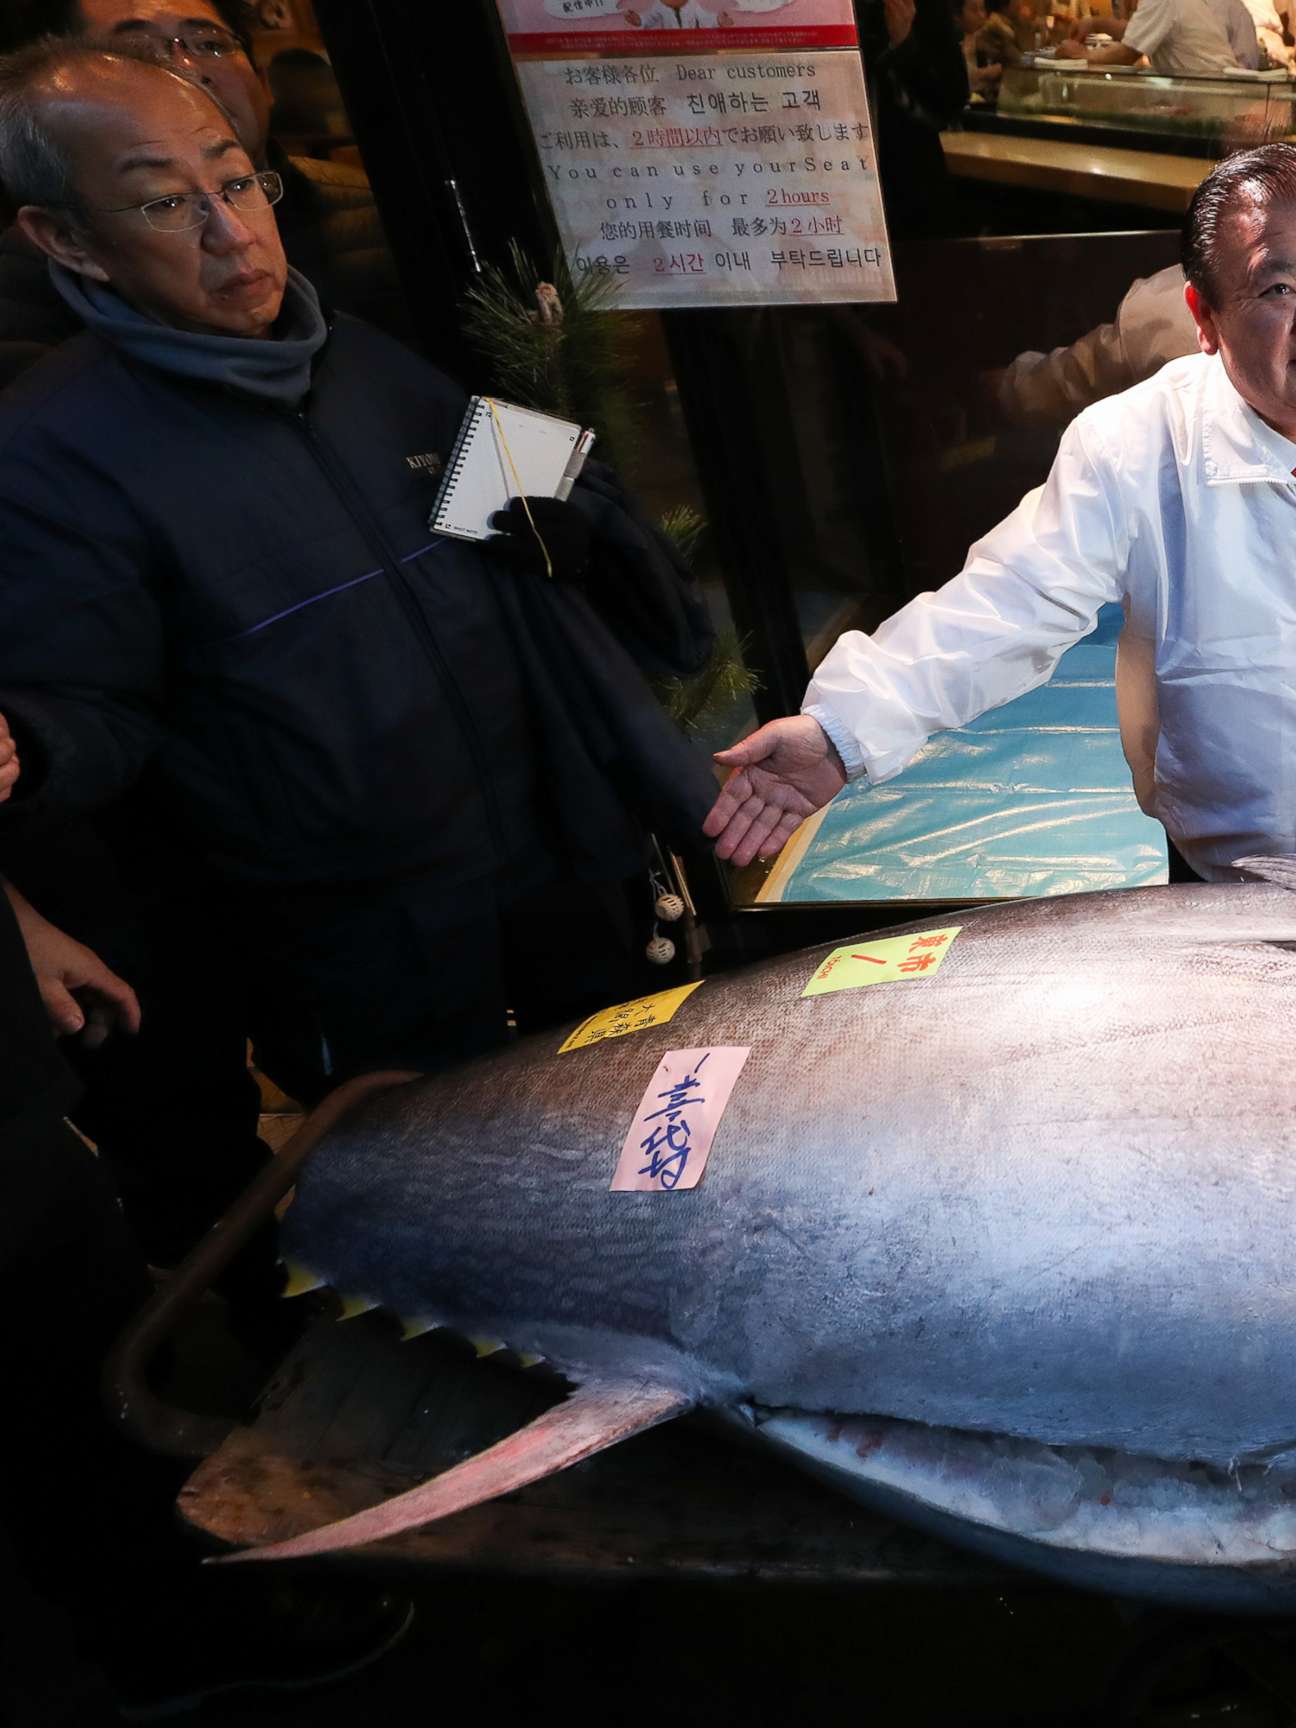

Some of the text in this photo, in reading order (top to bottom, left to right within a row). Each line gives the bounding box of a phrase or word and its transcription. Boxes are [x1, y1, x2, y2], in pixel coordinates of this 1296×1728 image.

[564, 64, 659, 85] お客様各位
[676, 63, 816, 81] Dear customers
[569, 95, 667, 118] 亲爱的顾客
[687, 89, 821, 114] 친애하는 고객
[549, 164, 597, 181] You
[612, 165, 658, 177] can
[674, 164, 719, 177] use
[606, 192, 673, 210] only
[703, 190, 749, 206] for
[600, 218, 712, 241] 您的用餐时间
[715, 250, 751, 271] 이내
[771, 247, 881, 271] 부탁드립니다
